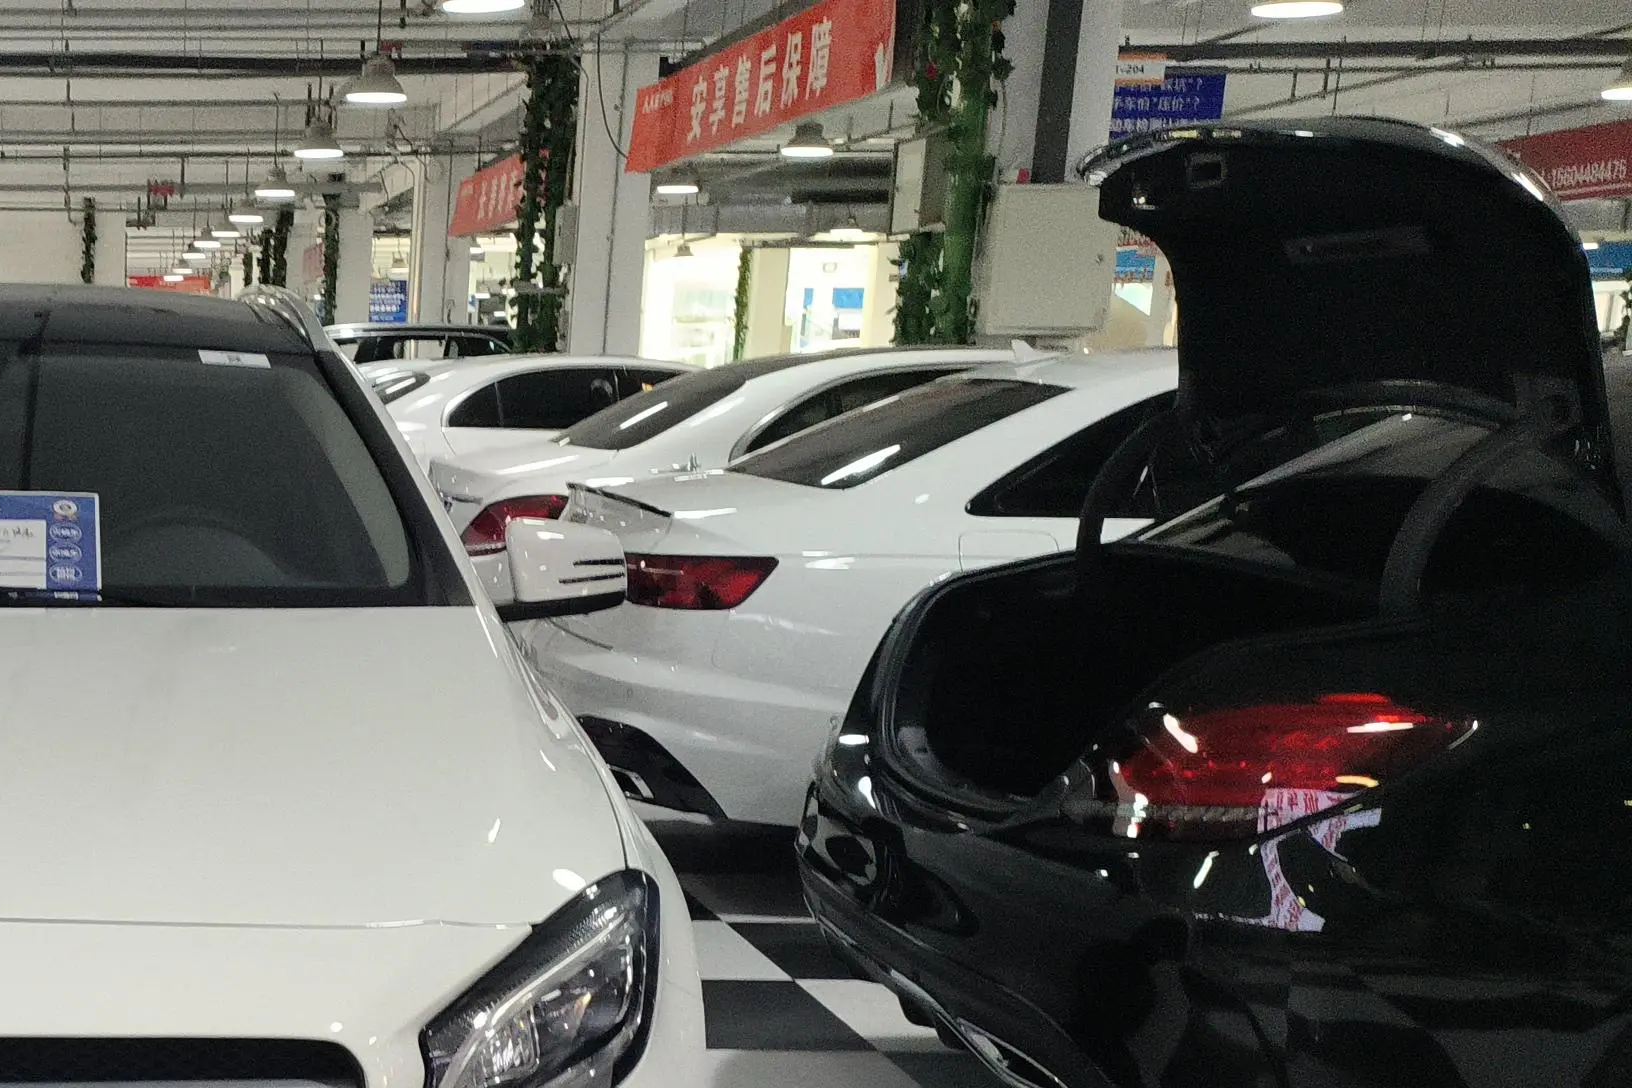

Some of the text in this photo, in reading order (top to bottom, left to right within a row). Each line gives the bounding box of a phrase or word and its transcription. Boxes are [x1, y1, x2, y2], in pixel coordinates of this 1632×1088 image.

[686, 17, 832, 141] 安享售后保障
